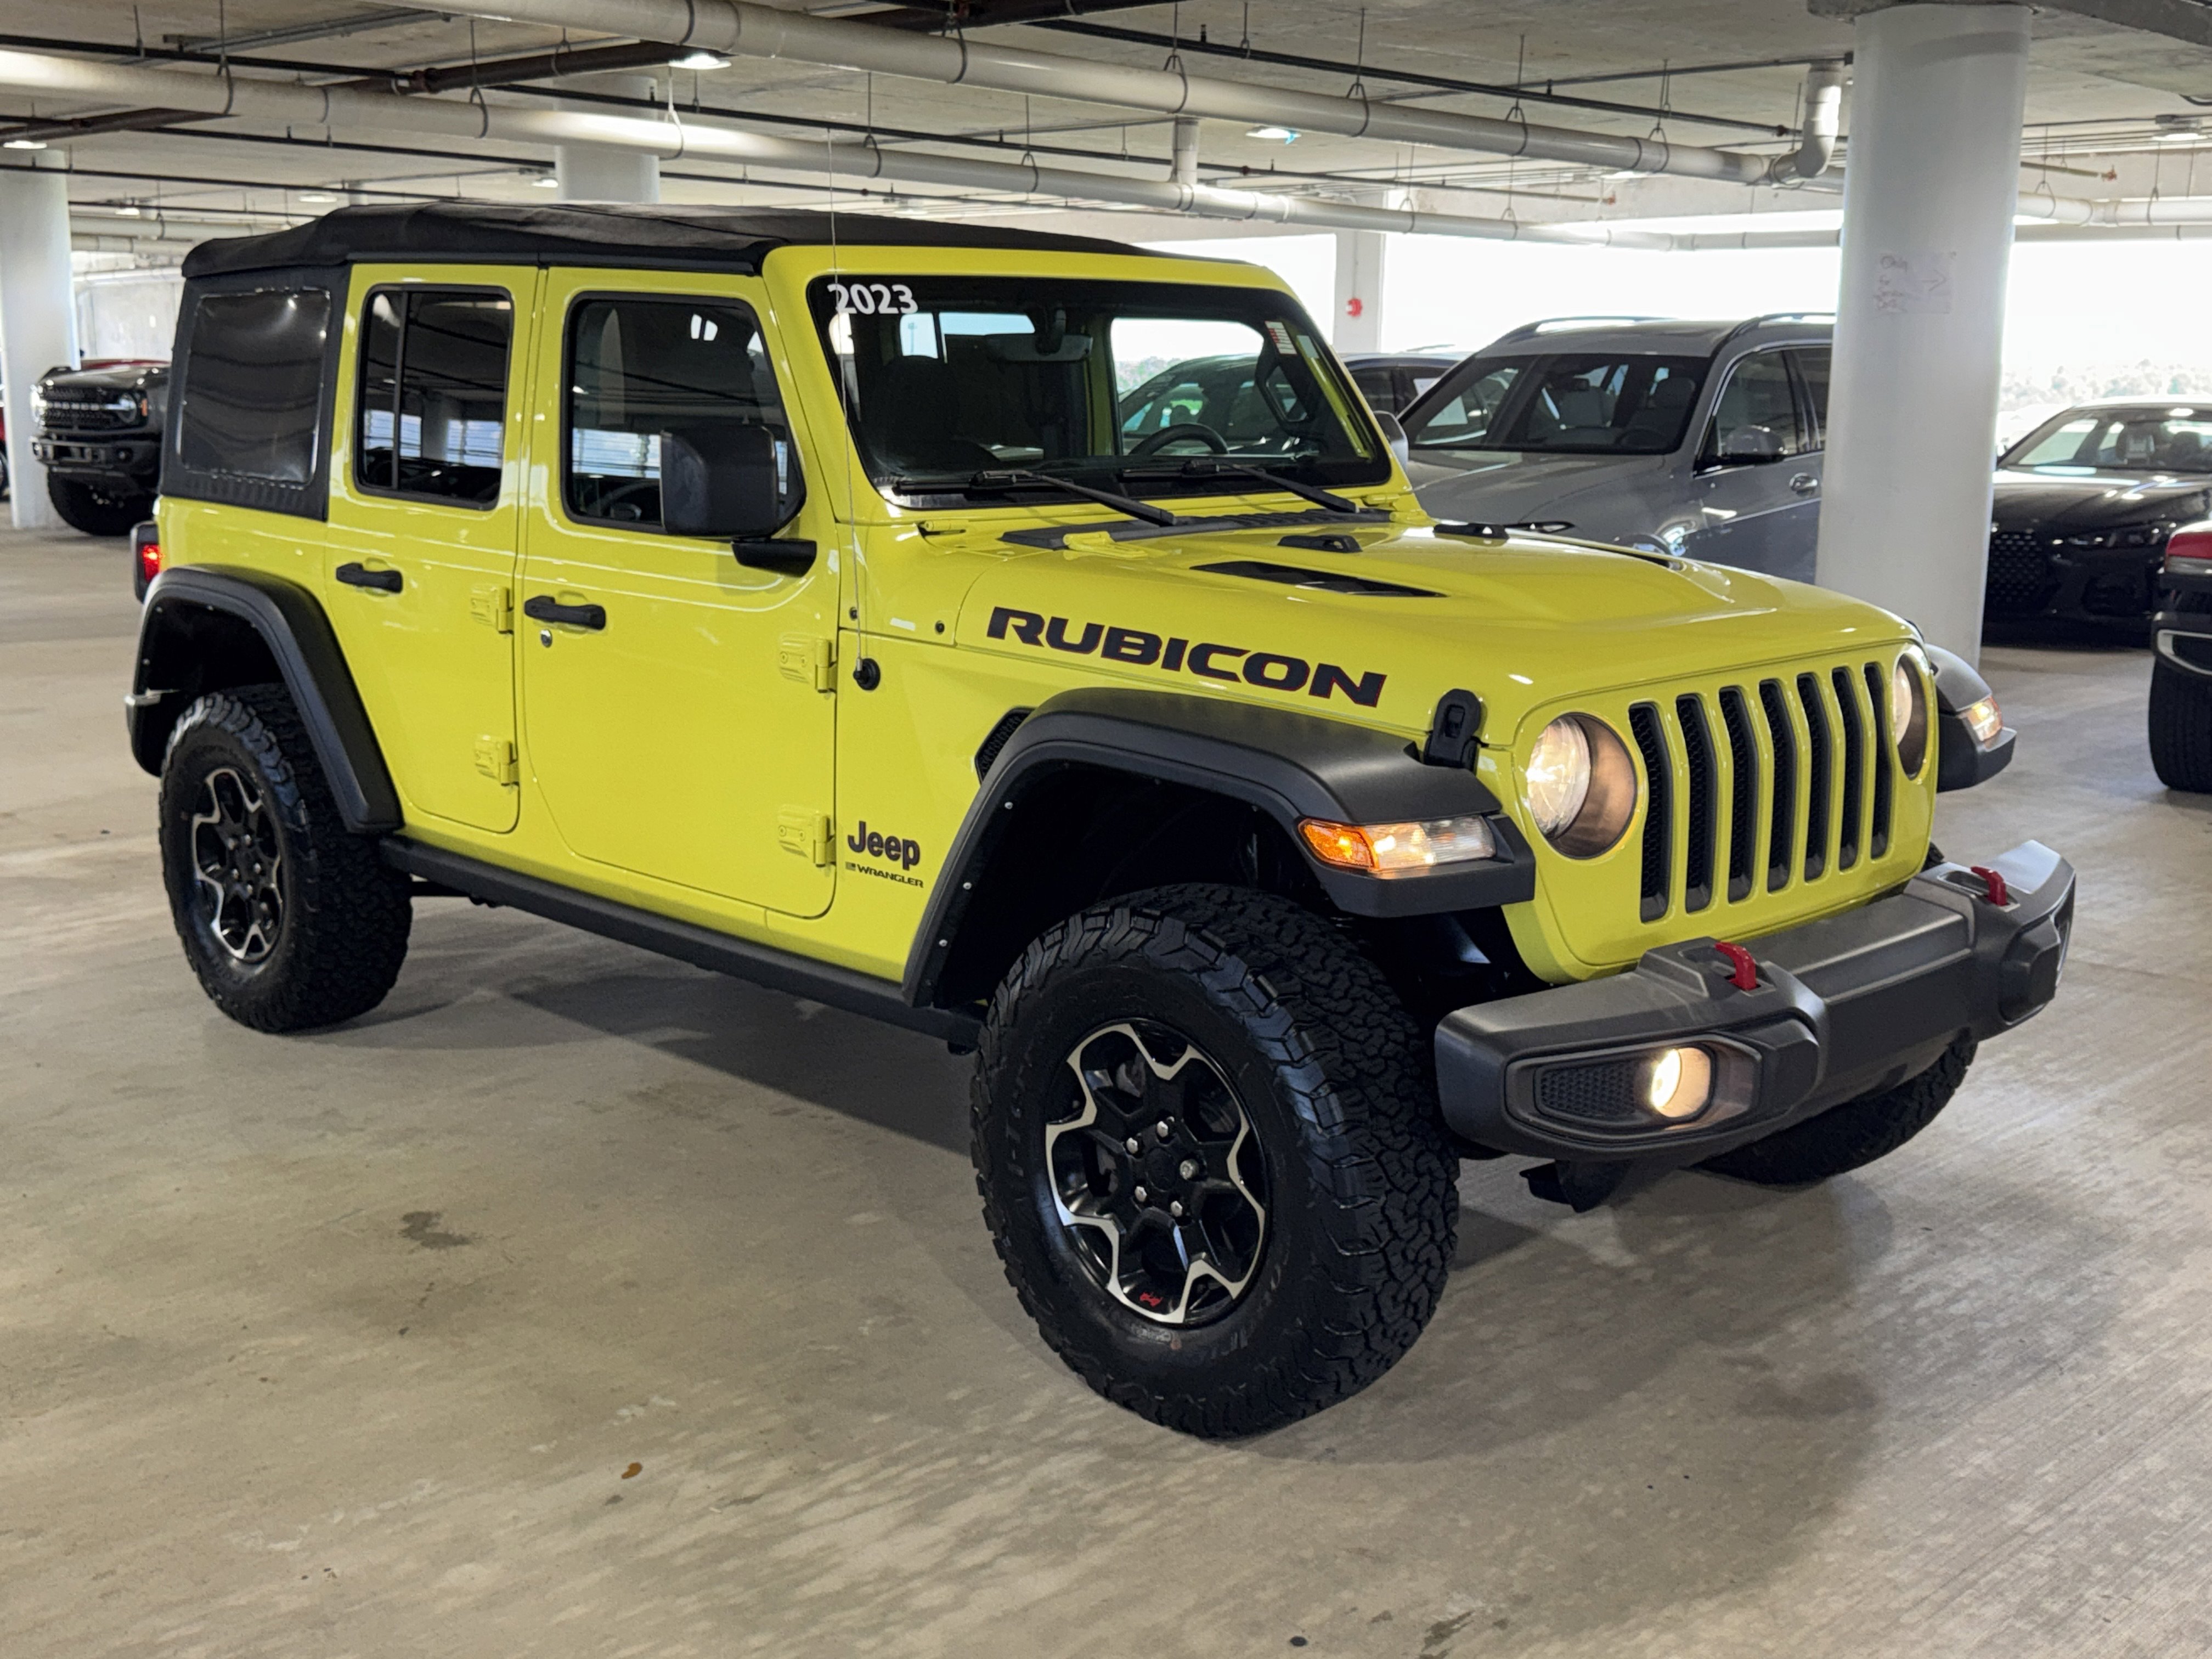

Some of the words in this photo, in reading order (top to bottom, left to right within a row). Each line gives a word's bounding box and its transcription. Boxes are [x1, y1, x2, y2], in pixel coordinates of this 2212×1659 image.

[827, 283, 918, 314] 2023
[986, 606, 1387, 708] RUBICON
[848, 820, 920, 871] Jeep
[857, 864, 924, 888] WRANGLER
